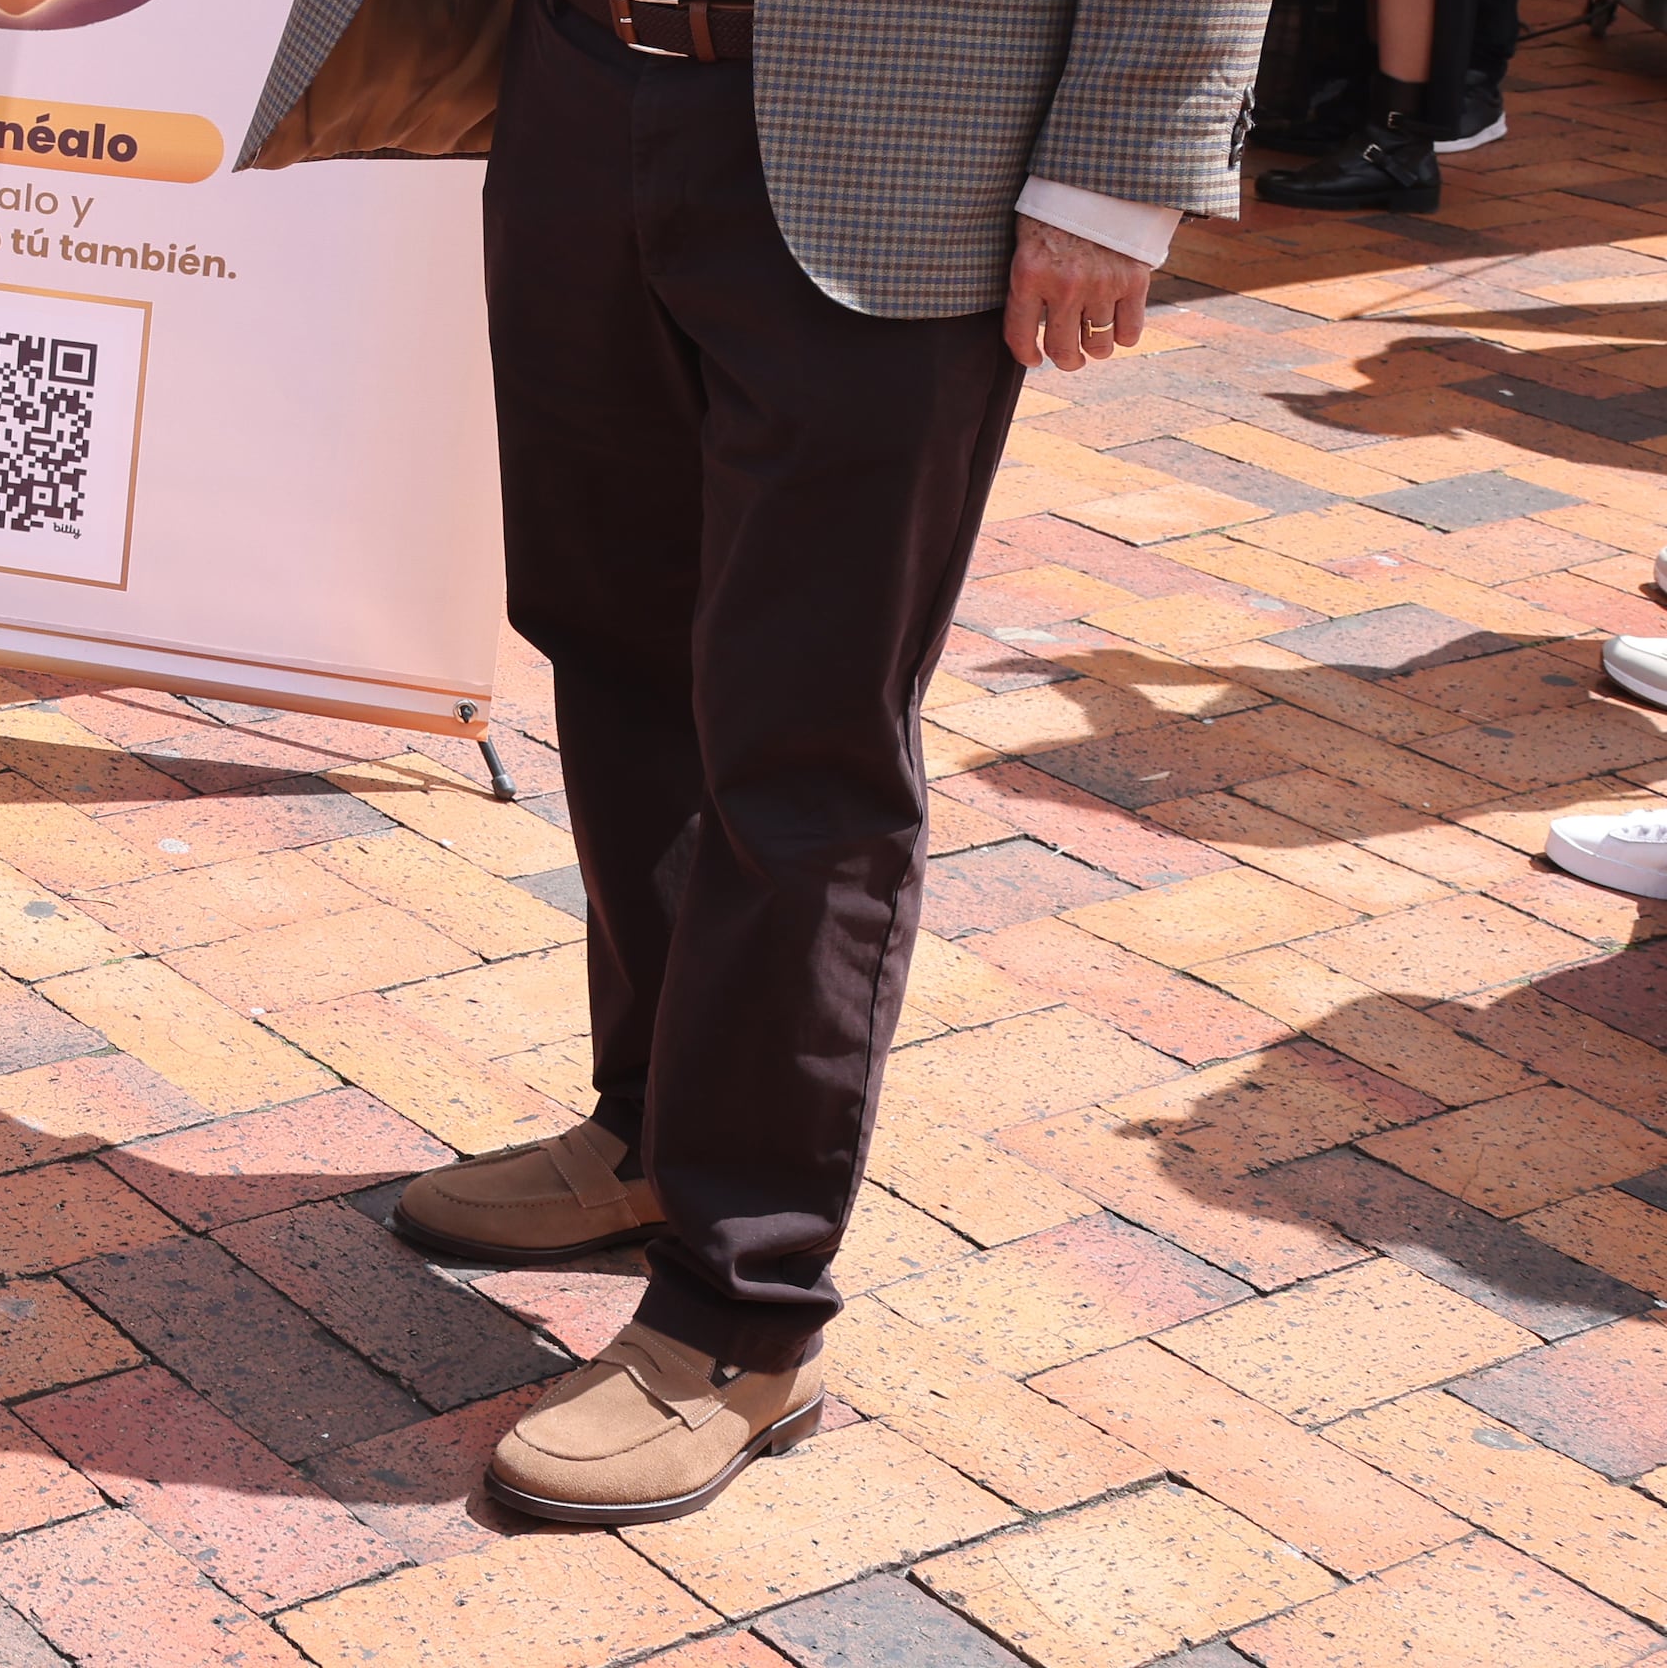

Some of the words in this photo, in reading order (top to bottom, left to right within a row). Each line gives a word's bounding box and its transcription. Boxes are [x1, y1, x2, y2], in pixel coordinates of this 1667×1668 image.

[71, 195, 95, 229] y
[10, 227, 50, 259] tú
[58, 234, 237, 280] también.
